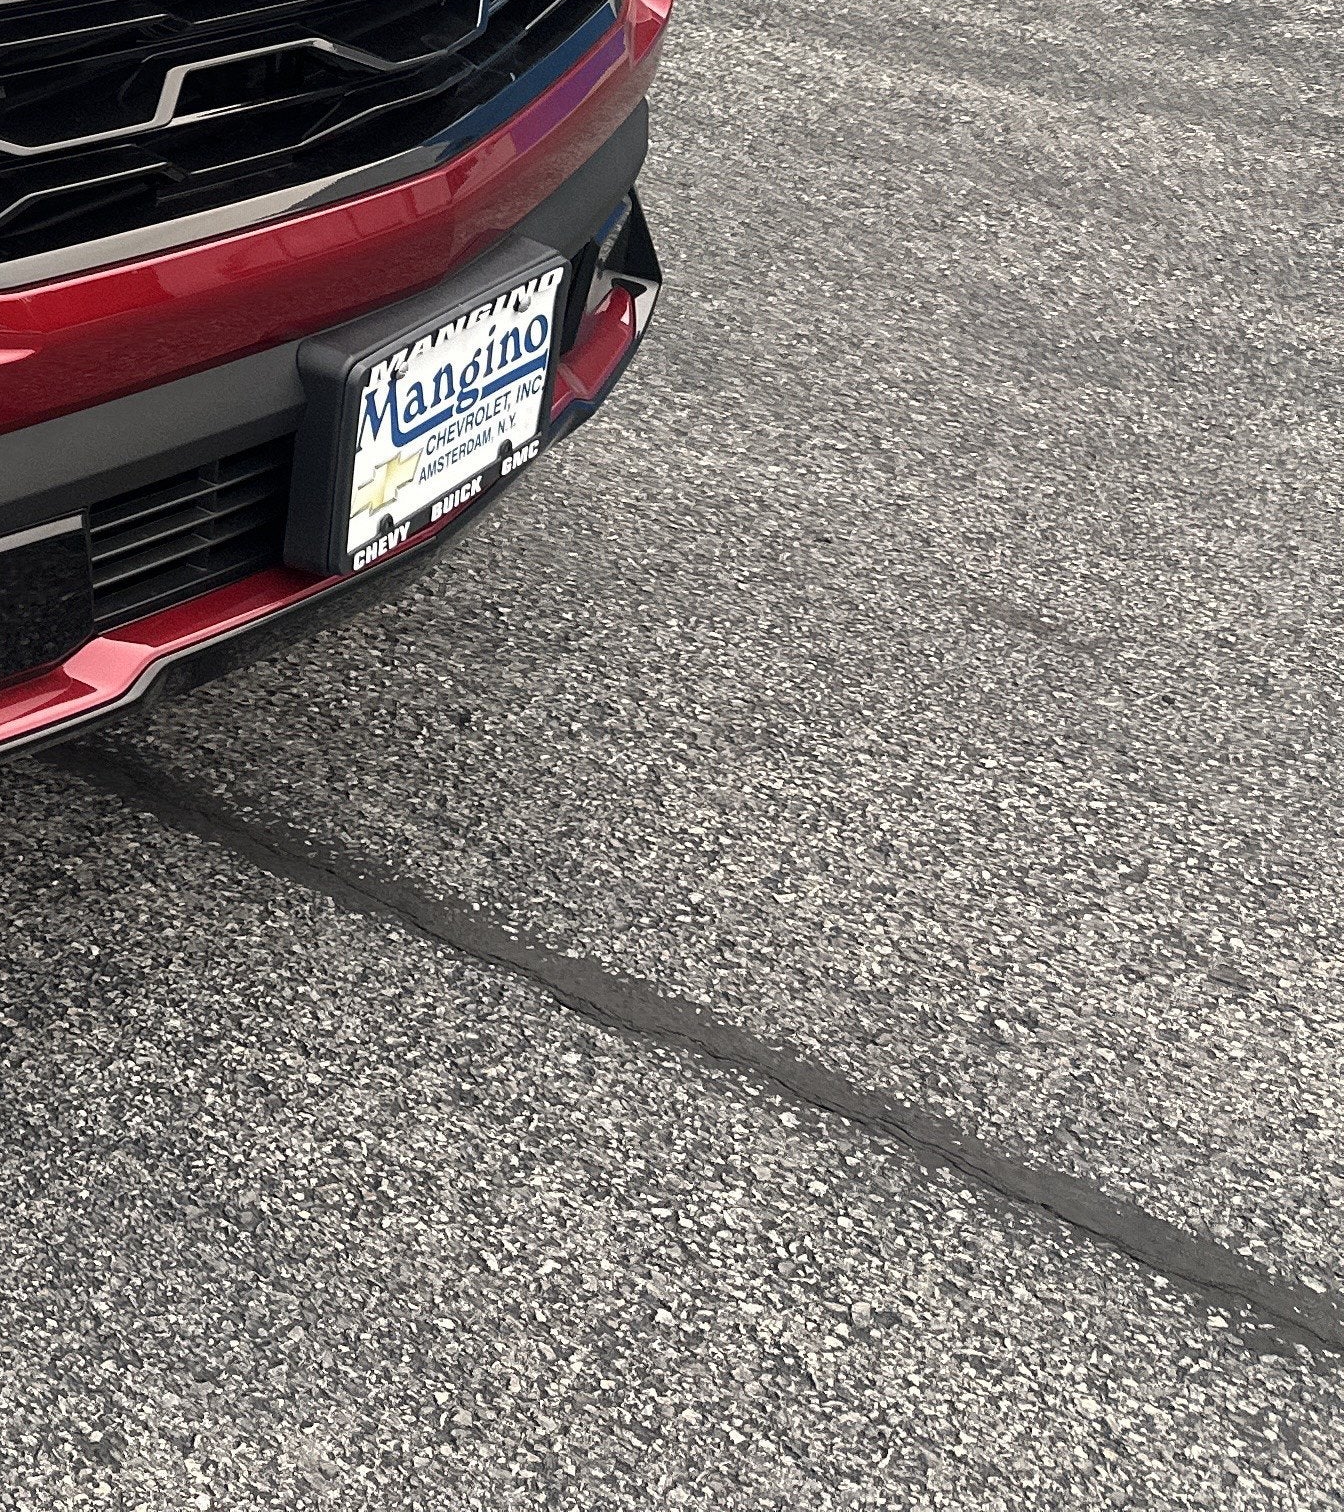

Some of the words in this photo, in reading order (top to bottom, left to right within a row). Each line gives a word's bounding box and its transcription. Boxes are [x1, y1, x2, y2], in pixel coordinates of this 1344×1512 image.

[362, 314, 549, 447] Mangino
[368, 267, 564, 387] MANGINO
[426, 390, 512, 456] CHEVROLET,
[353, 522, 412, 571] CHEVY
[431, 475, 483, 523] BUICK
[500, 439, 540, 476] GMC
